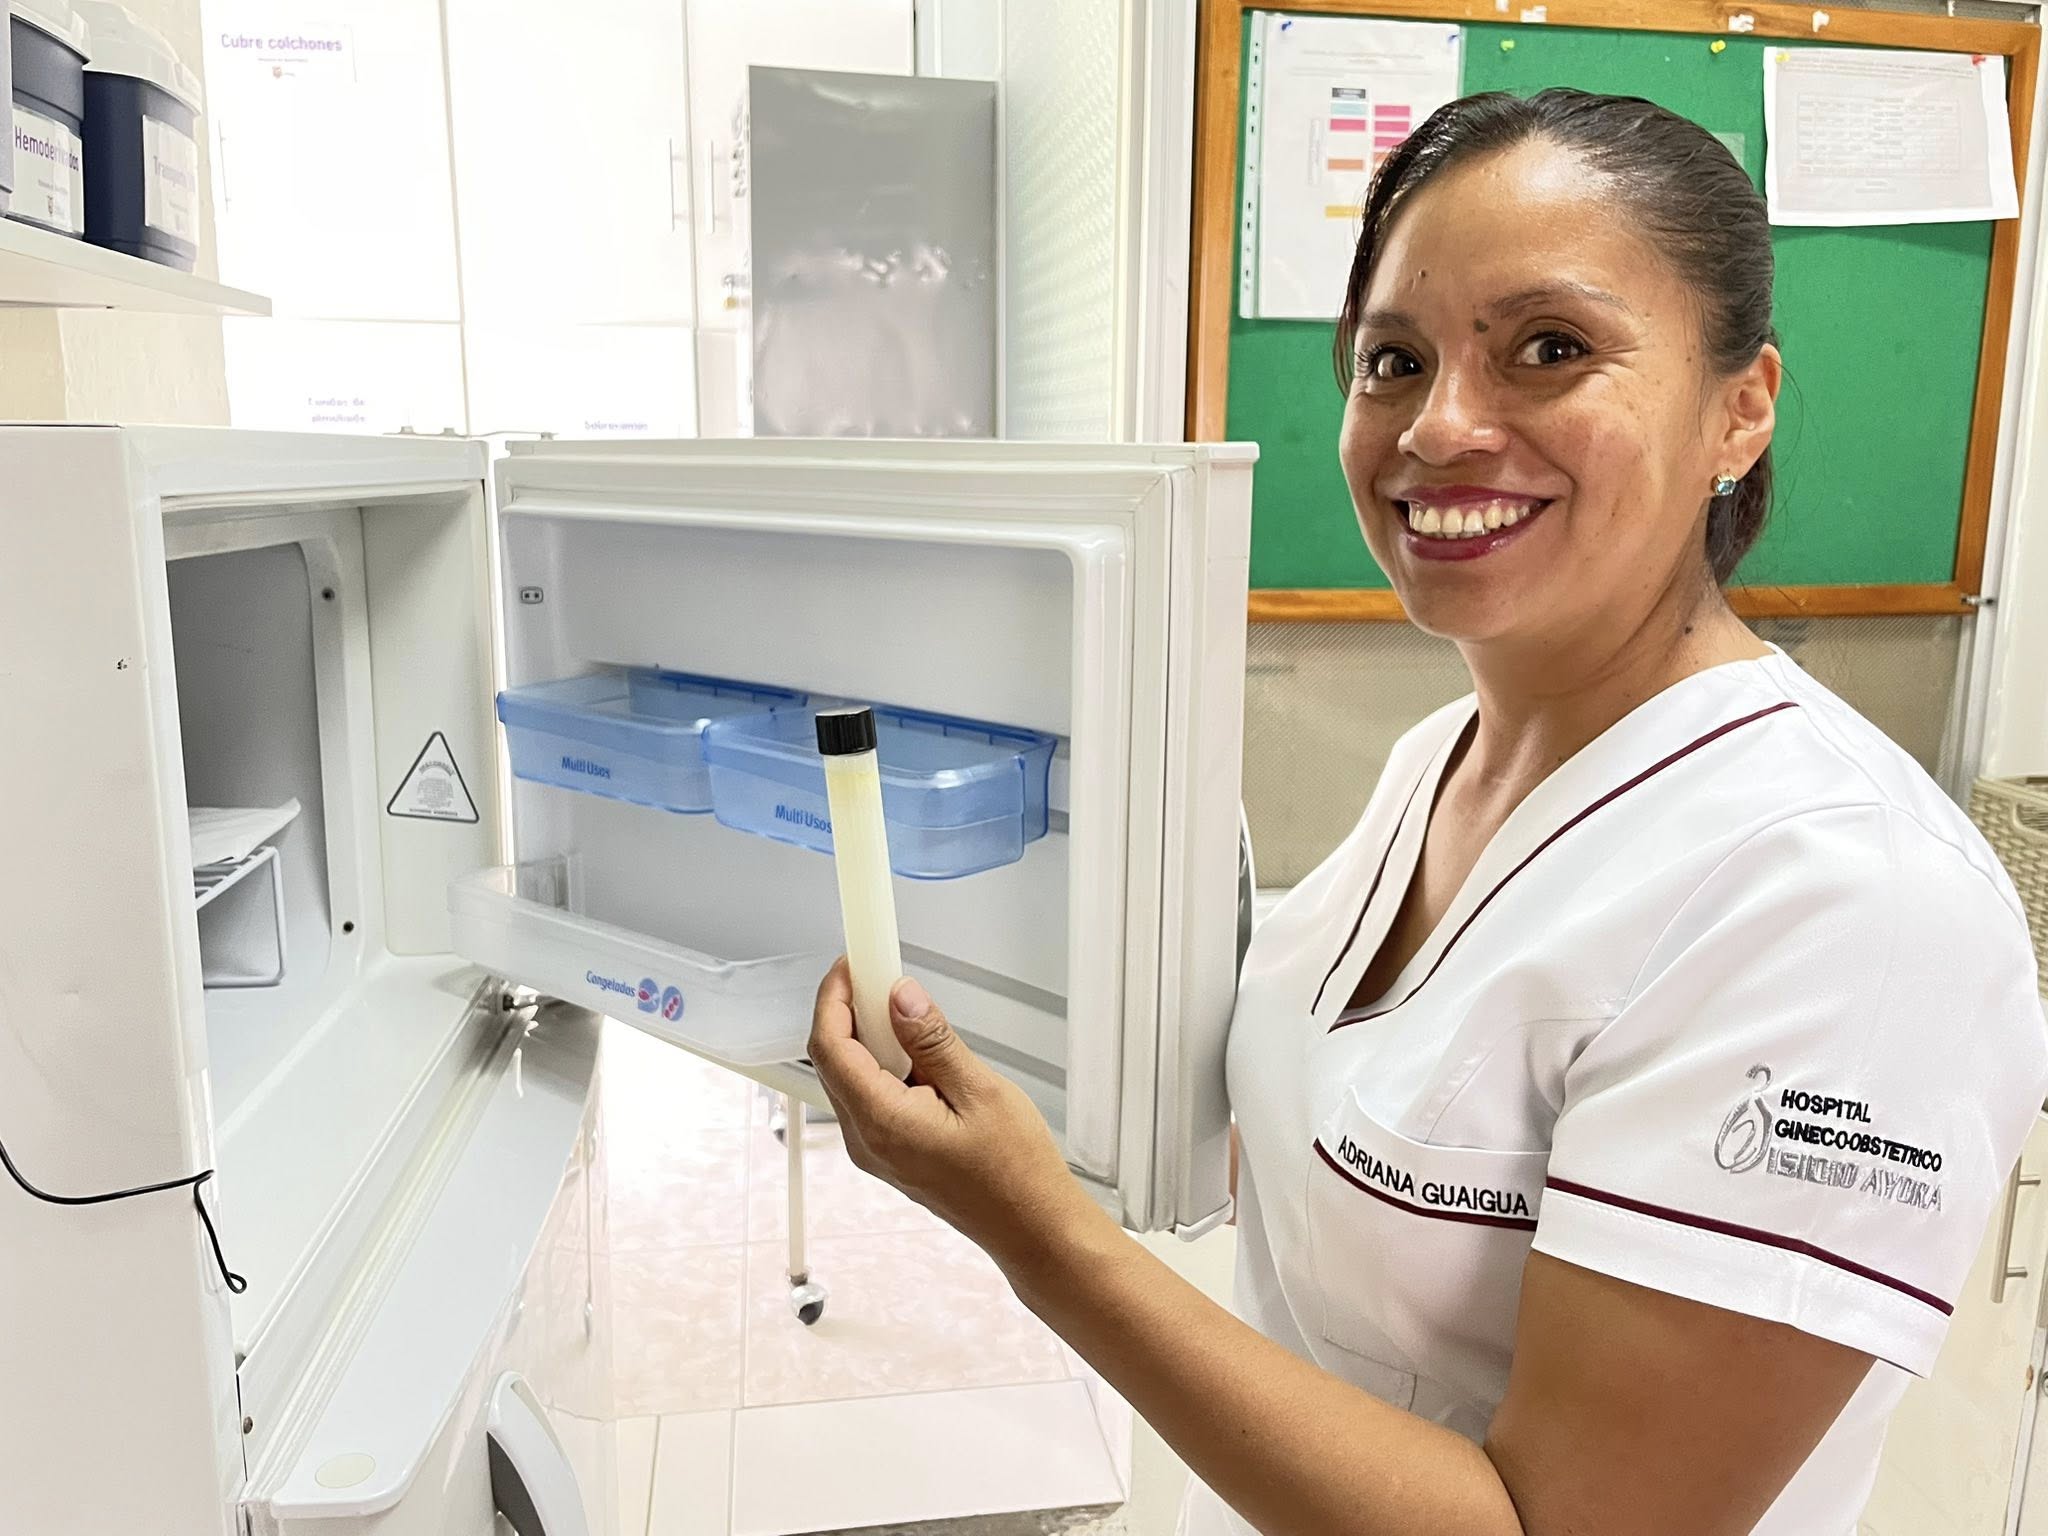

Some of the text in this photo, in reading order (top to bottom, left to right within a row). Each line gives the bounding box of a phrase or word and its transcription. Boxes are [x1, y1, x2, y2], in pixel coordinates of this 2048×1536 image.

[221, 33, 342, 51] Cubre colchones
[15, 126, 79, 171] Hemoderidos
[561, 756, 610, 780] Multi Usos
[775, 804, 833, 834] Multi Usos
[586, 969, 635, 998] Congelados
[1781, 1089, 1872, 1123] HOSPITAL
[1338, 1135, 1530, 1217] ADRIANA GUAIGUA
